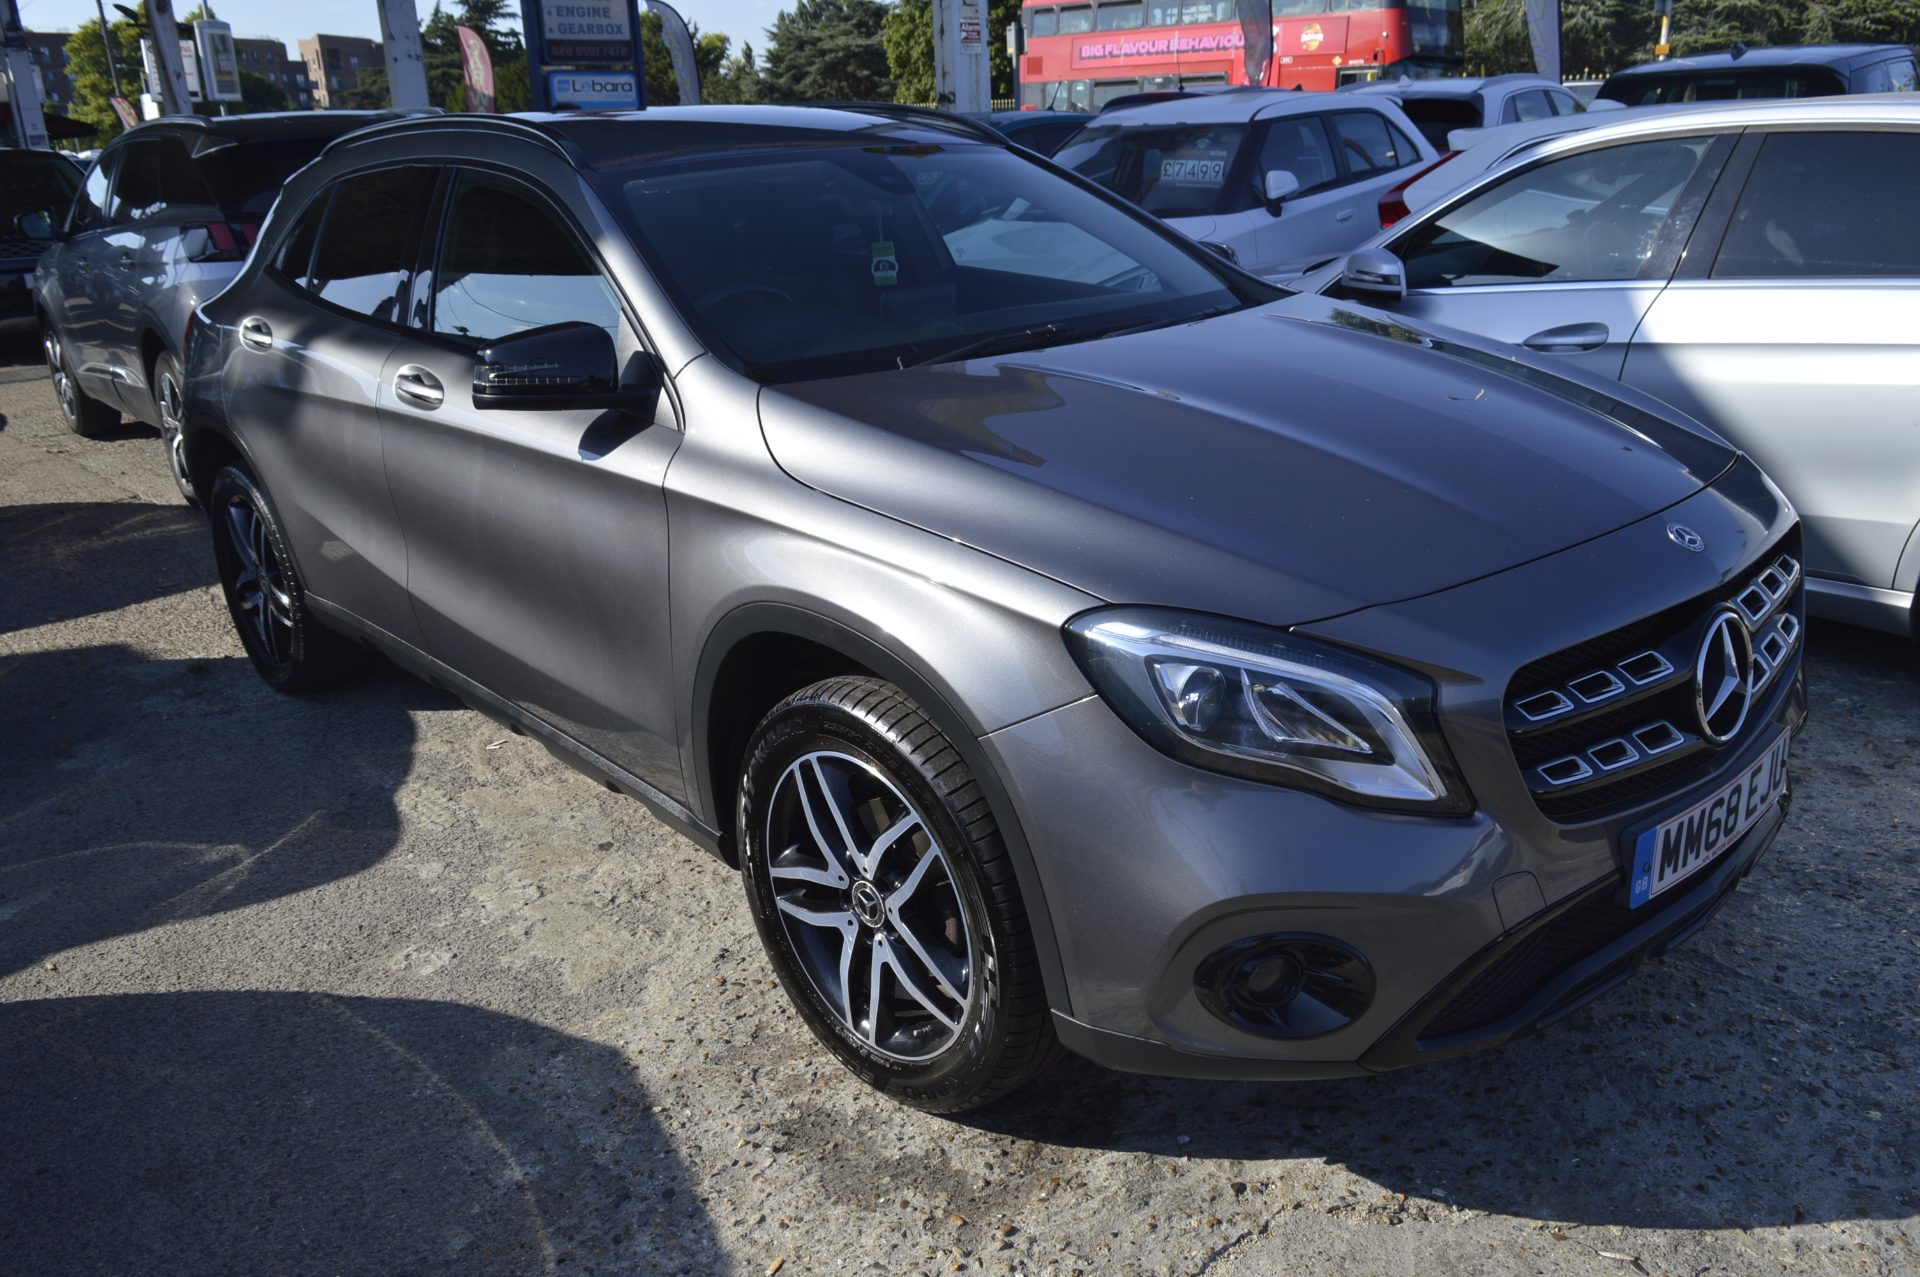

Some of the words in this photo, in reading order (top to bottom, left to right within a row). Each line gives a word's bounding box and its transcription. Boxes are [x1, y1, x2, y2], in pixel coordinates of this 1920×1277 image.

[556, 6, 611, 19] ENGINE
[558, 23, 624, 35] GEARBOX
[1080, 43, 1107, 59] BIG
[1106, 38, 1168, 58] FLAVOUR
[1169, 33, 1245, 53] BEHAVIOU
[572, 79, 633, 93] Lebara
[1162, 162, 1222, 179] £7499
[1658, 783, 1742, 883] MM68
[1744, 738, 1788, 822] EJU
[1635, 876, 1648, 894] GB
